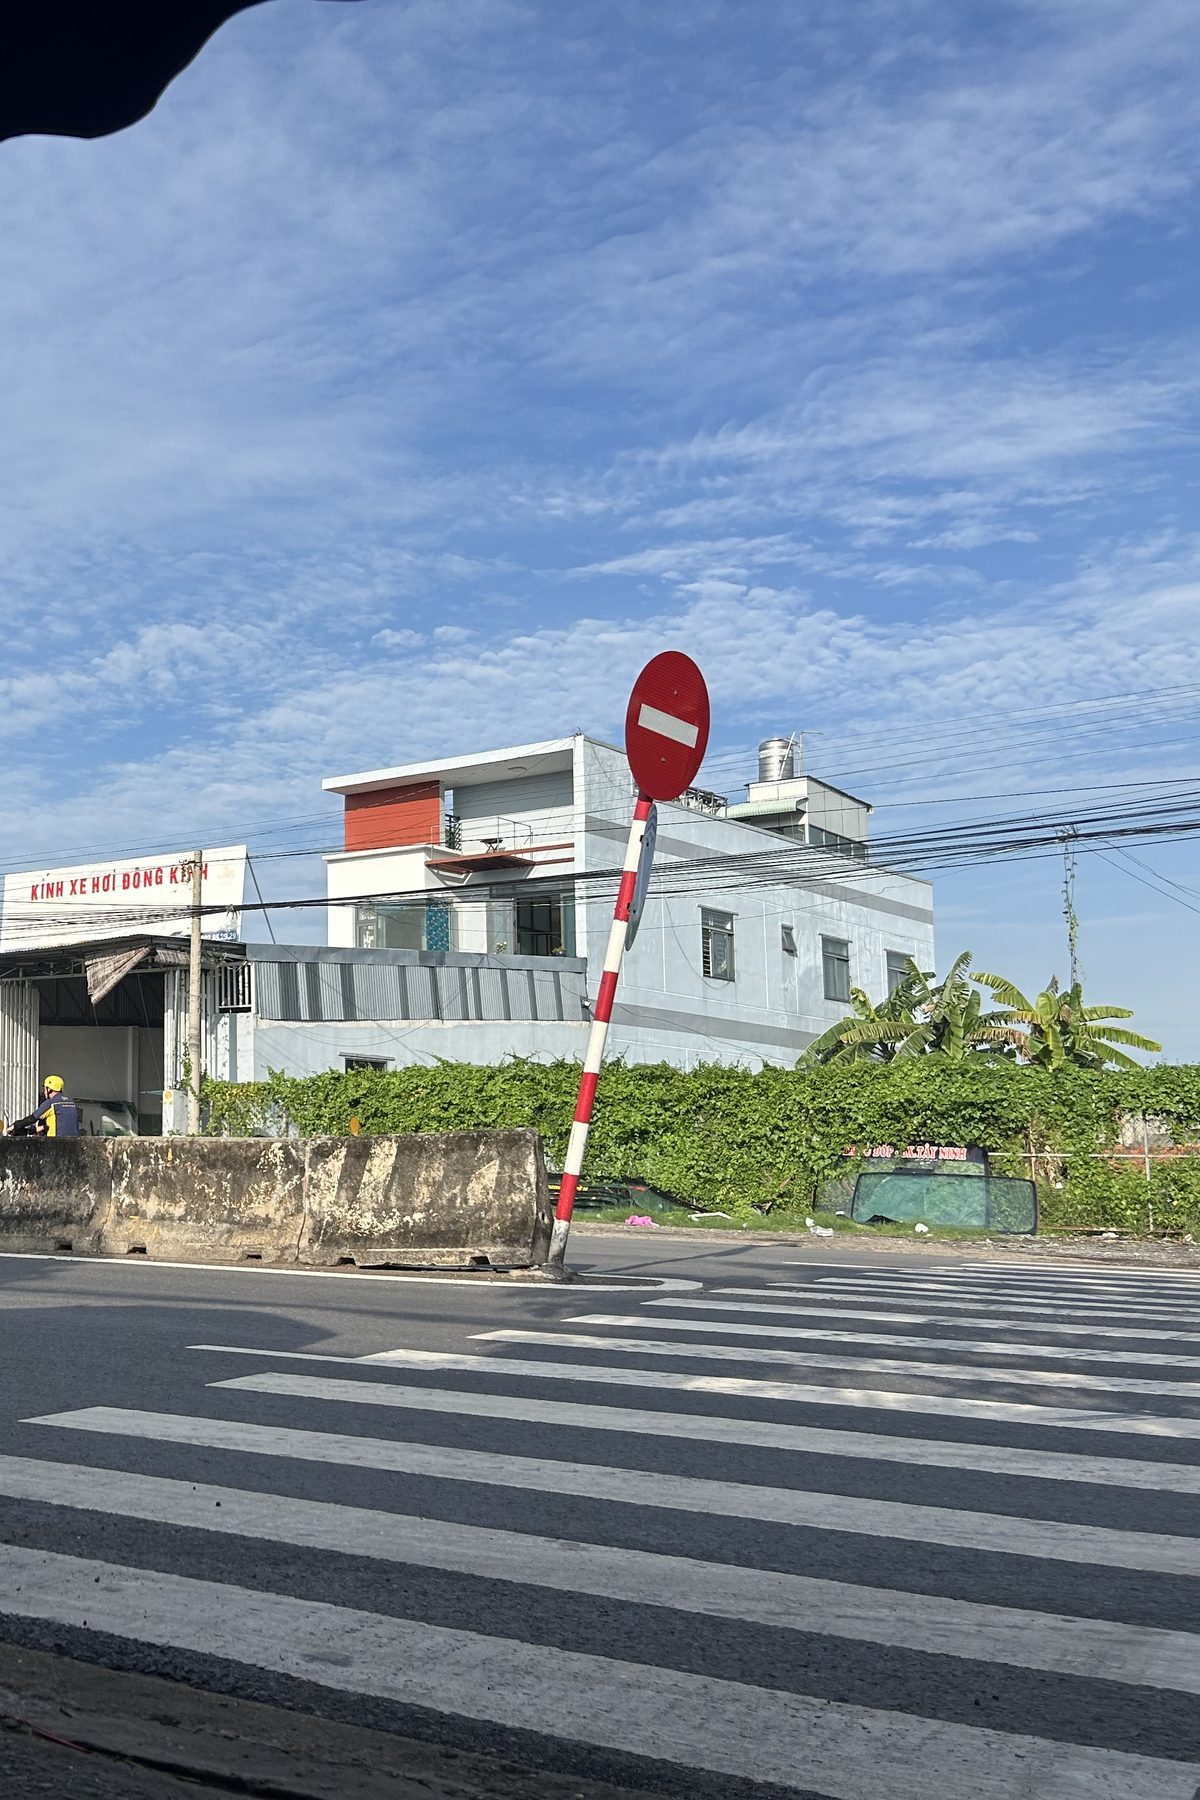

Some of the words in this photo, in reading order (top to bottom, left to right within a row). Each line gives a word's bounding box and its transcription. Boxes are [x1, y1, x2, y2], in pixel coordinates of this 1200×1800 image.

[69, 878, 86, 896] XE
[122, 867, 164, 890] ĐÔNG
[939, 1147, 967, 1160] NINH
